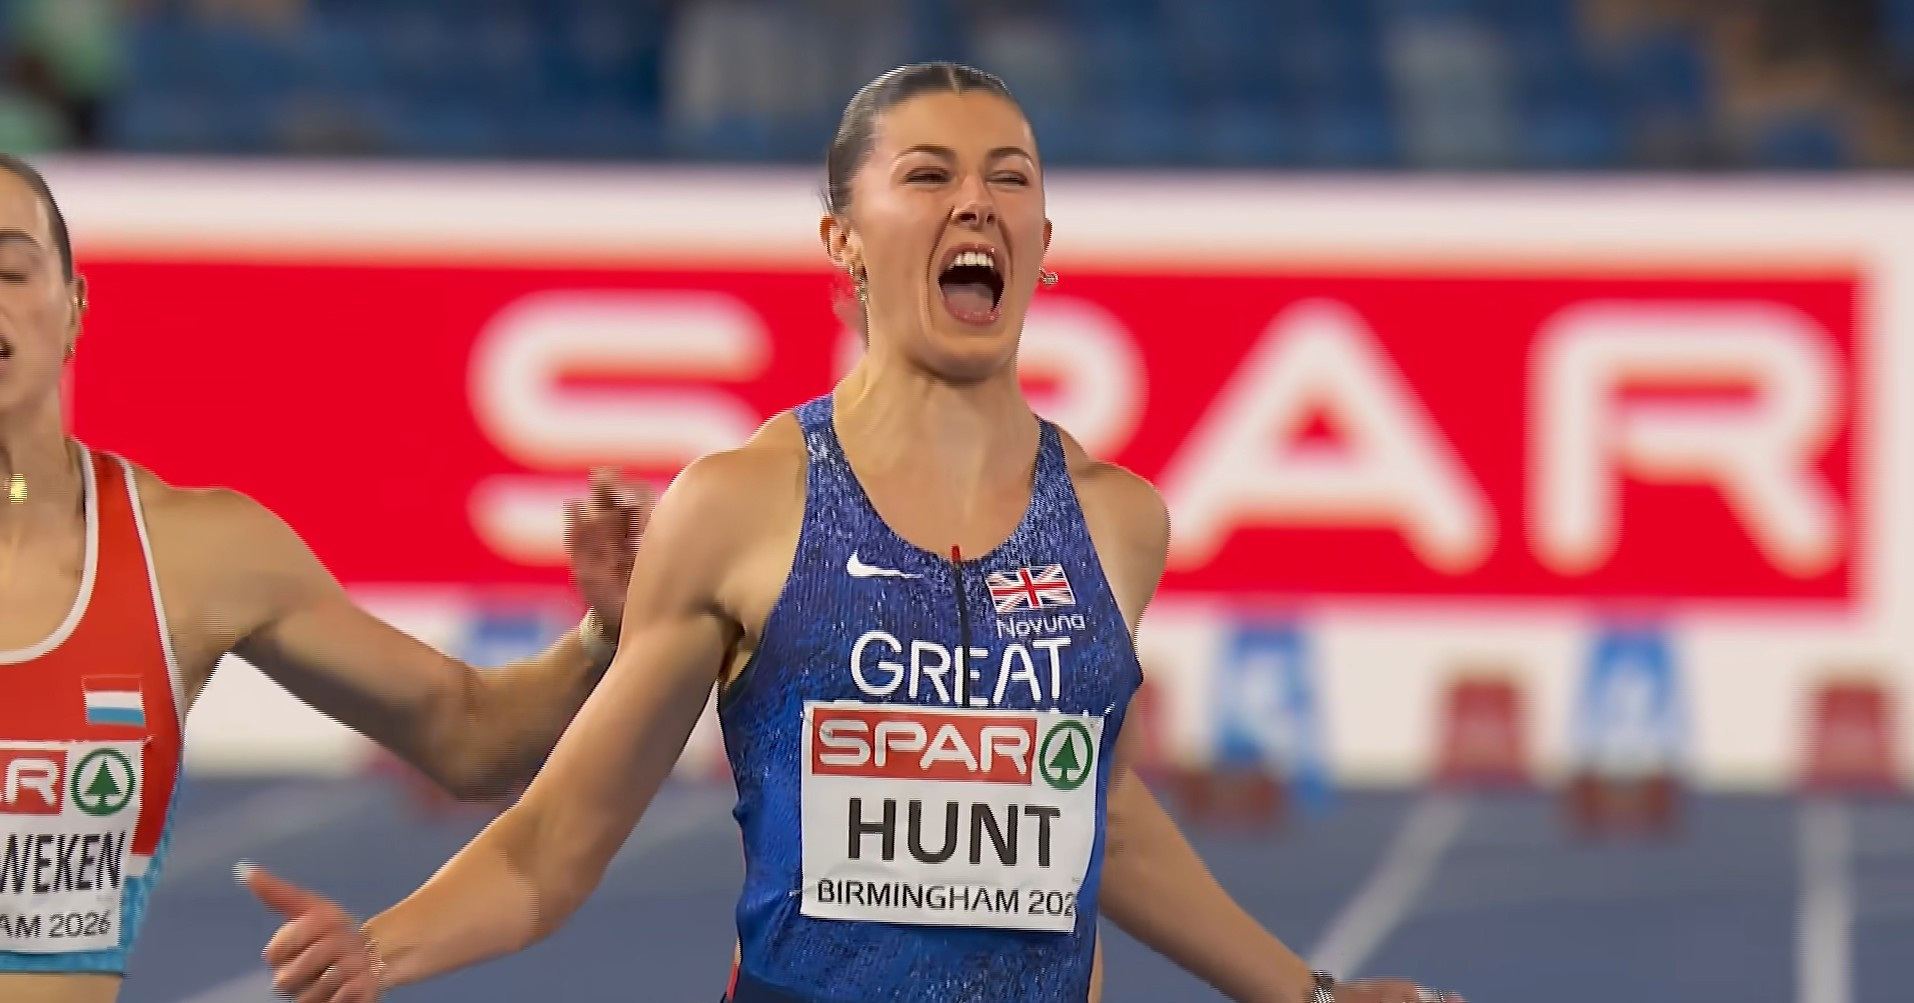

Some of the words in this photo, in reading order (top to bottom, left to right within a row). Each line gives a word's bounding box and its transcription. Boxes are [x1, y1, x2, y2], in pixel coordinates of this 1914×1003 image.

[466, 288, 1850, 578] SAR
[850, 630, 1072, 707] GREAT
[818, 719, 1031, 775] SPAR
[848, 797, 1062, 869] HUNT
[48, 909, 112, 940] 2026
[817, 878, 1020, 914] BIRMINGHAM
